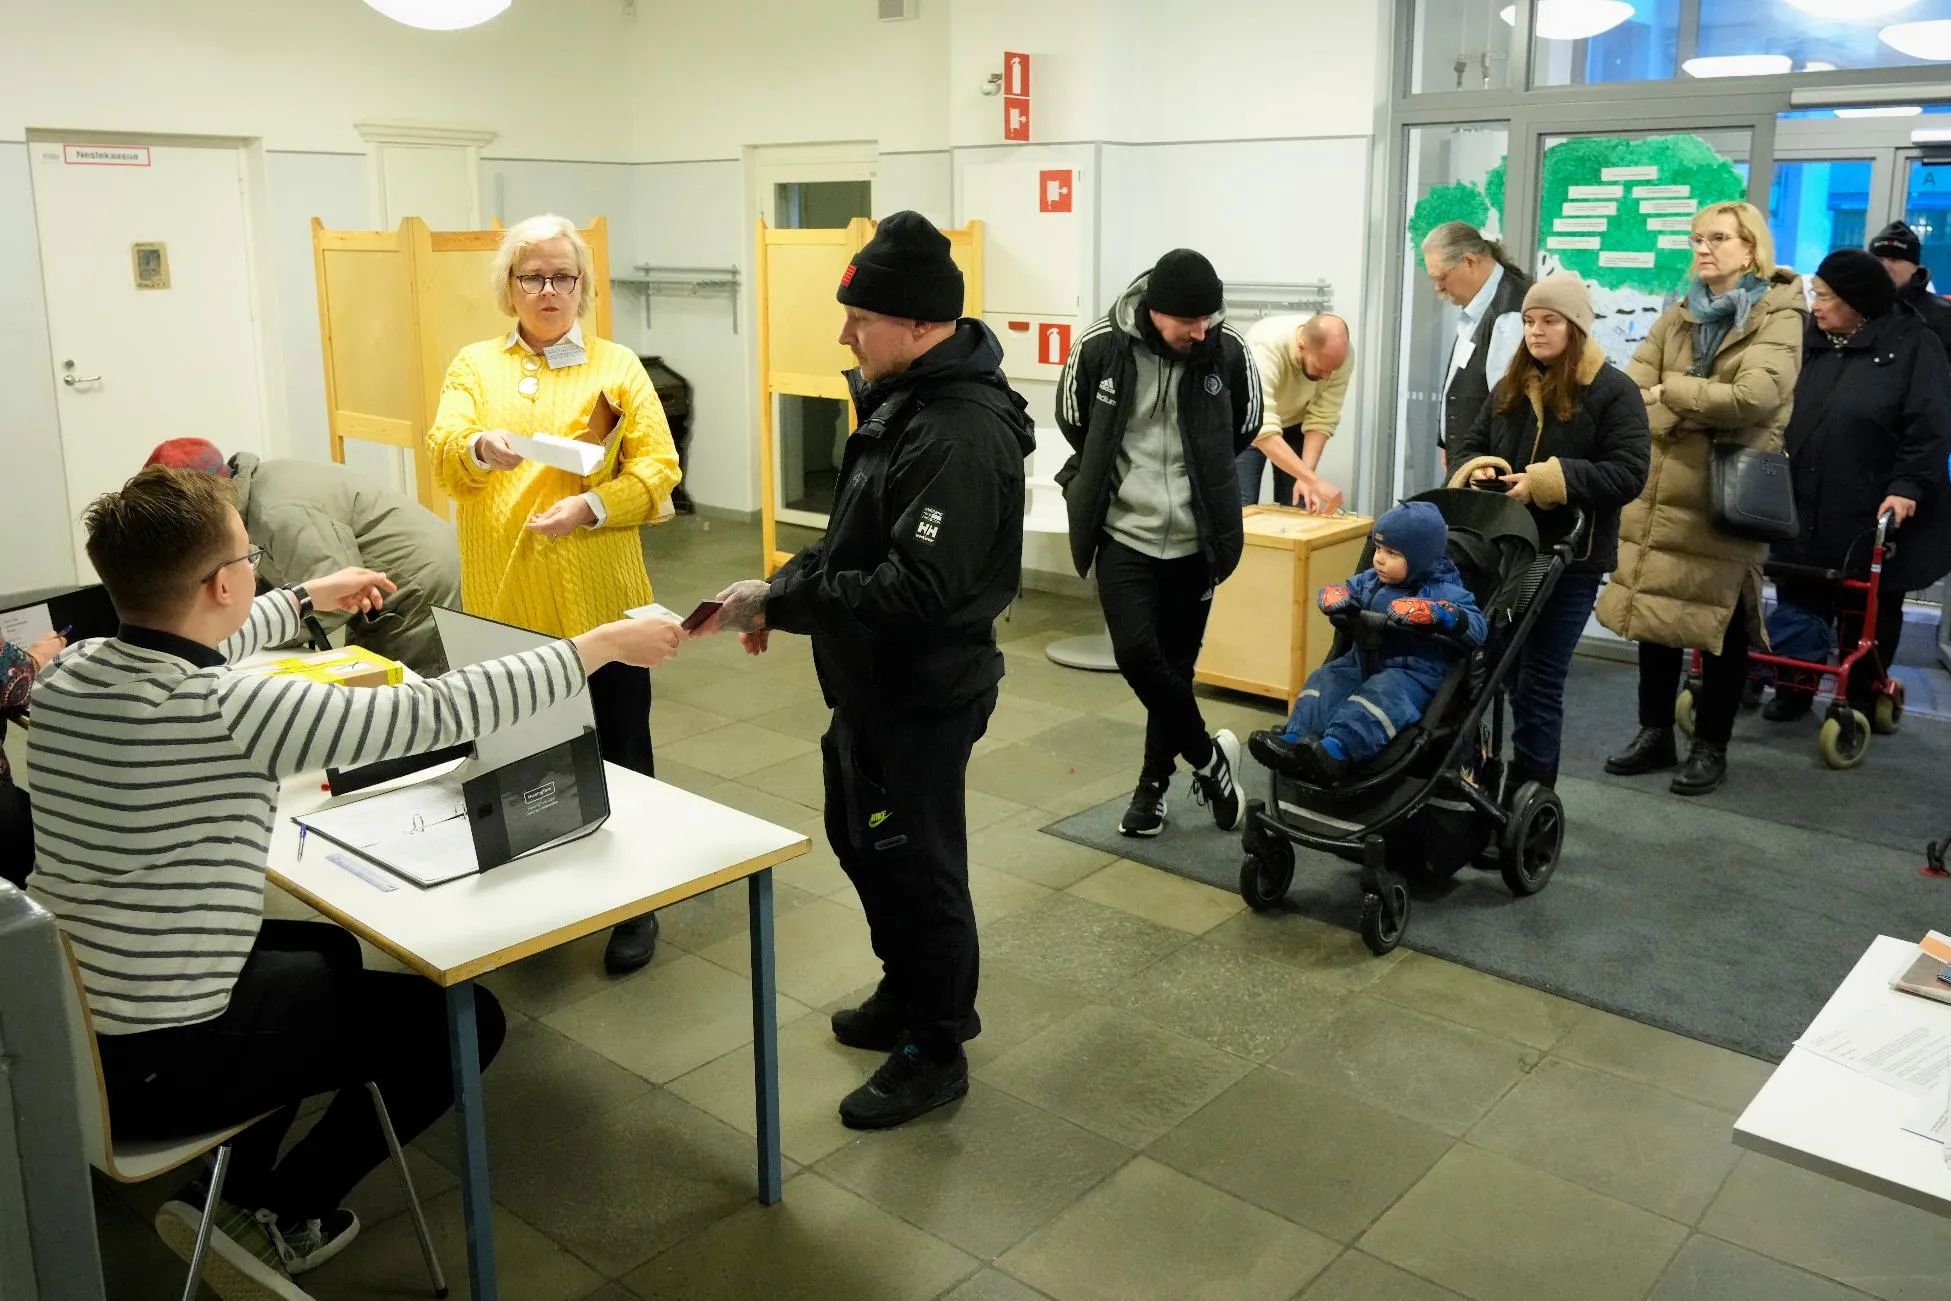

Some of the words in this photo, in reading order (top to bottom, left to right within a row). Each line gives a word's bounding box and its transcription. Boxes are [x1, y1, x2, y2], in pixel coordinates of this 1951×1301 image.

[76, 150, 139, 160] Nestekaasua
[1923, 172, 1935, 186] A
[917, 521, 938, 538] HH
